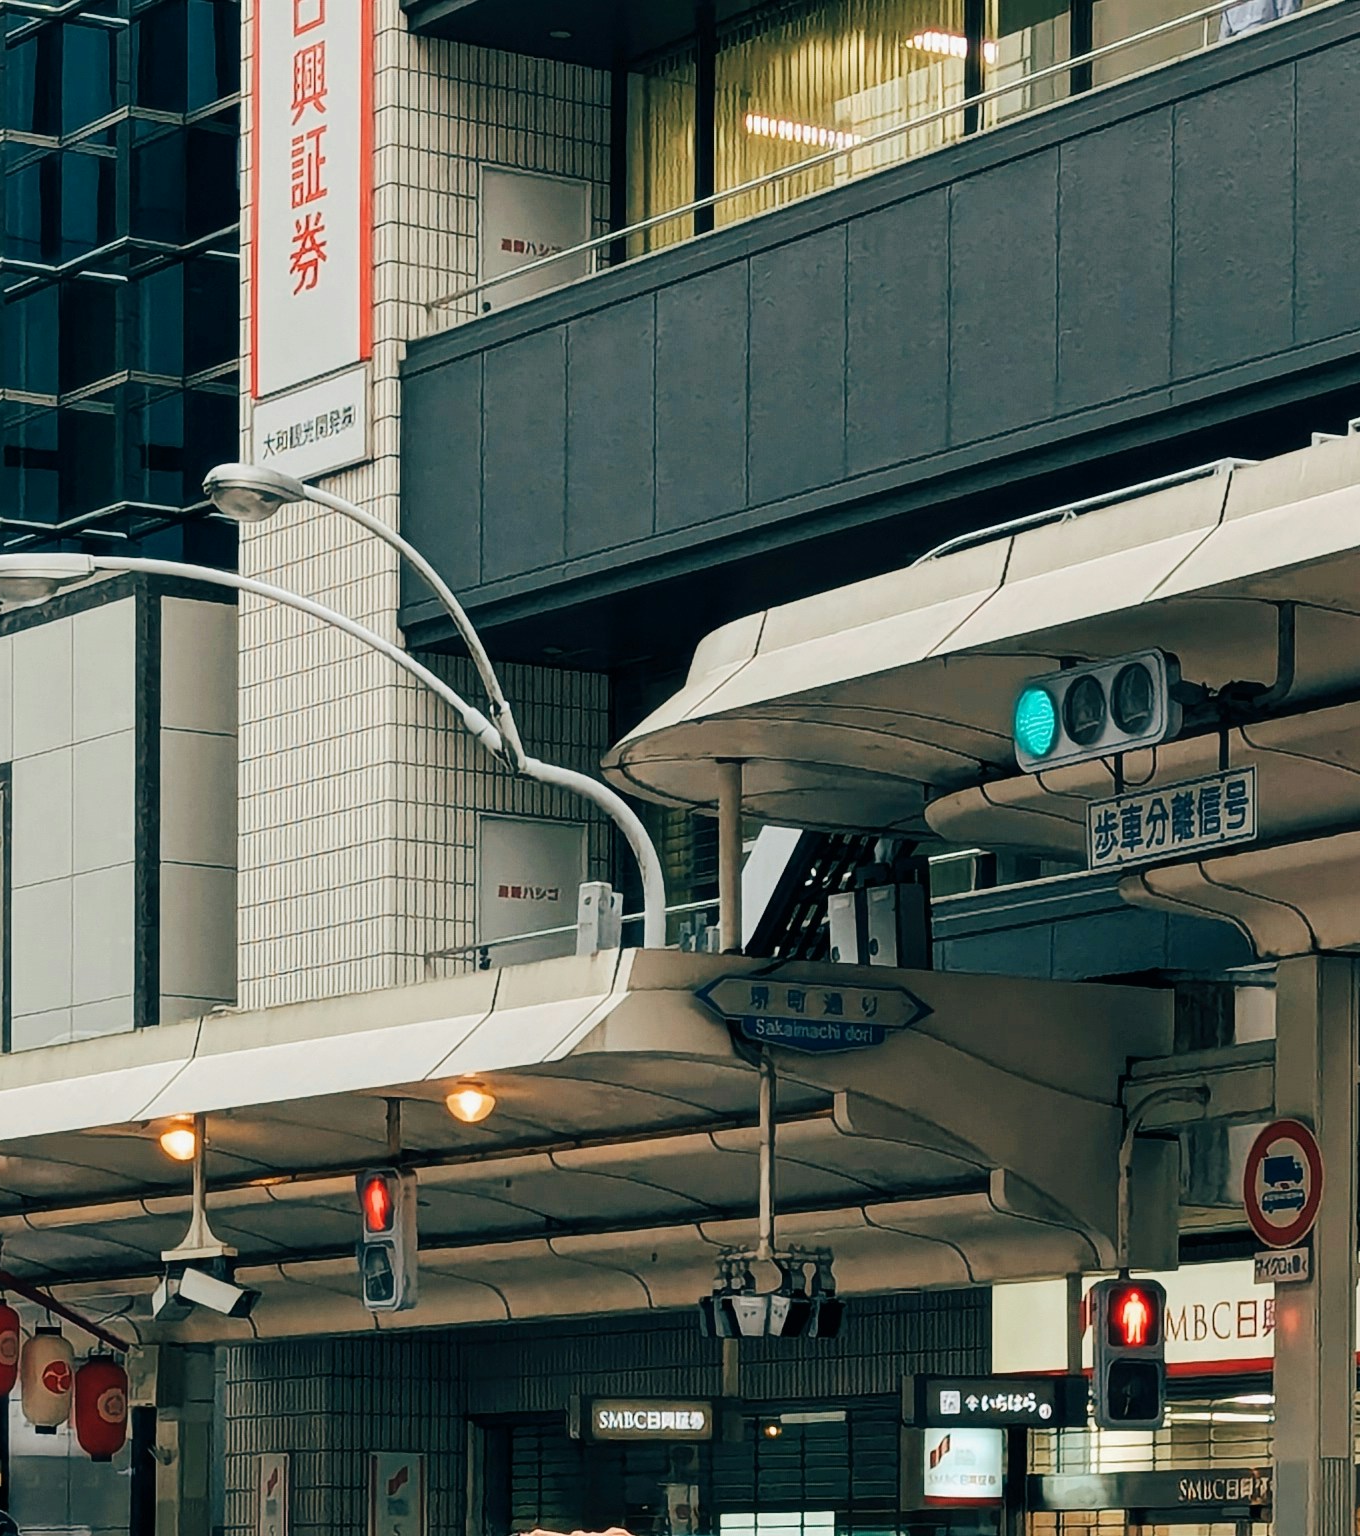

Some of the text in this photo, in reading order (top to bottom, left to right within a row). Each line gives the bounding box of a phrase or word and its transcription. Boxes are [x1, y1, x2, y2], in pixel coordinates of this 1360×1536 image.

[1095, 780, 1249, 860] 歩車分離信号
[755, 1018, 873, 1043] Sakaimachi dori
